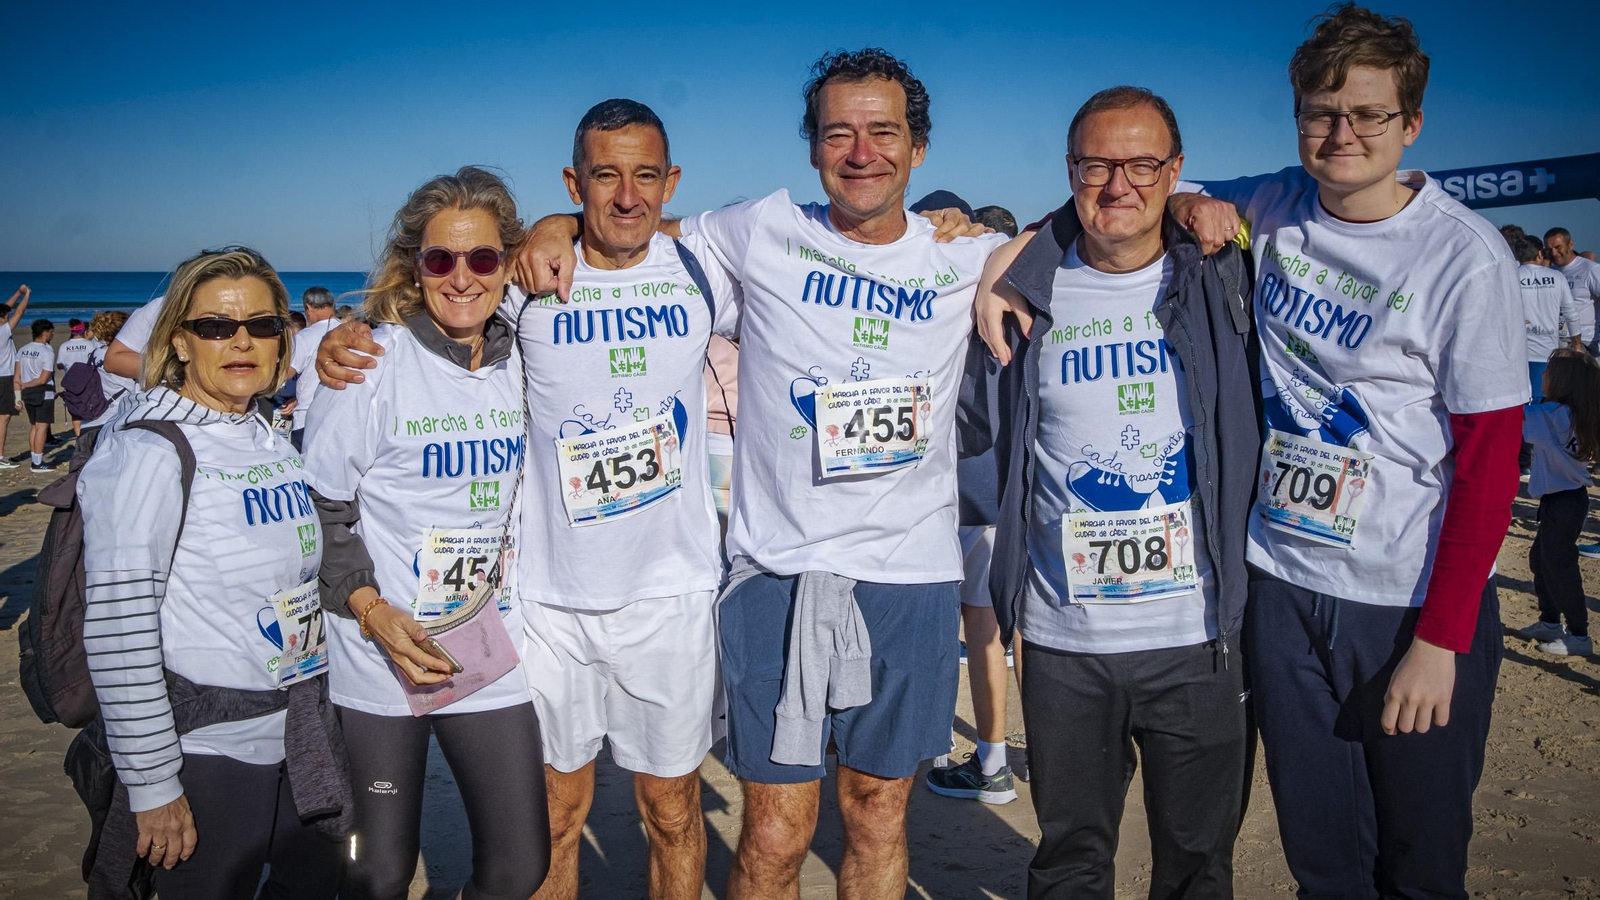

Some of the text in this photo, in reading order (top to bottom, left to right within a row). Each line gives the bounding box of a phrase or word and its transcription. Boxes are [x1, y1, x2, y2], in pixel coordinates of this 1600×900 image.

[935, 265, 960, 287] del
[612, 287, 621, 298] a
[801, 270, 938, 323] AUTISMO
[1316, 269, 1328, 285] a
[1334, 271, 1378, 303] favor
[1386, 288, 1414, 313] del
[1260, 272, 1373, 350] AUTISMO
[553, 304, 690, 345] AUTISMO
[1051, 317, 1112, 345] marcha
[1123, 316, 1133, 332] a
[832, 389, 859, 399] MARCHA
[870, 387, 890, 395] FAVOR
[893, 386, 902, 394] DEL
[828, 400, 850, 409] CIUDAD
[406, 412, 468, 436] marcha
[475, 413, 484, 430] a
[845, 406, 915, 444] 455
[573, 441, 597, 452] MARCHA
[606, 435, 627, 446] FAVOR
[629, 431, 640, 440] DEL
[835, 445, 884, 457] FERNANDO
[571, 452, 590, 462] CIUDAD
[1081, 430, 1185, 491] Cada paso cuenta
[1300, 445, 1319, 456] FAVOR
[1320, 450, 1331, 460] DEL
[272, 461, 285, 473] a
[586, 448, 660, 494] 453
[1272, 461, 1337, 510] 709
[597, 495, 616, 505] ANA
[1080, 520, 1105, 529] MARCHA
[1139, 517, 1151, 525] DEL
[1075, 530, 1096, 538] CIUDAD
[434, 546, 455, 554] CIUDAD
[1088, 536, 1168, 575] 708
[443, 556, 502, 592] 454
[288, 592, 307, 606] MARCHA
[368, 786, 398, 795] Kalenji
